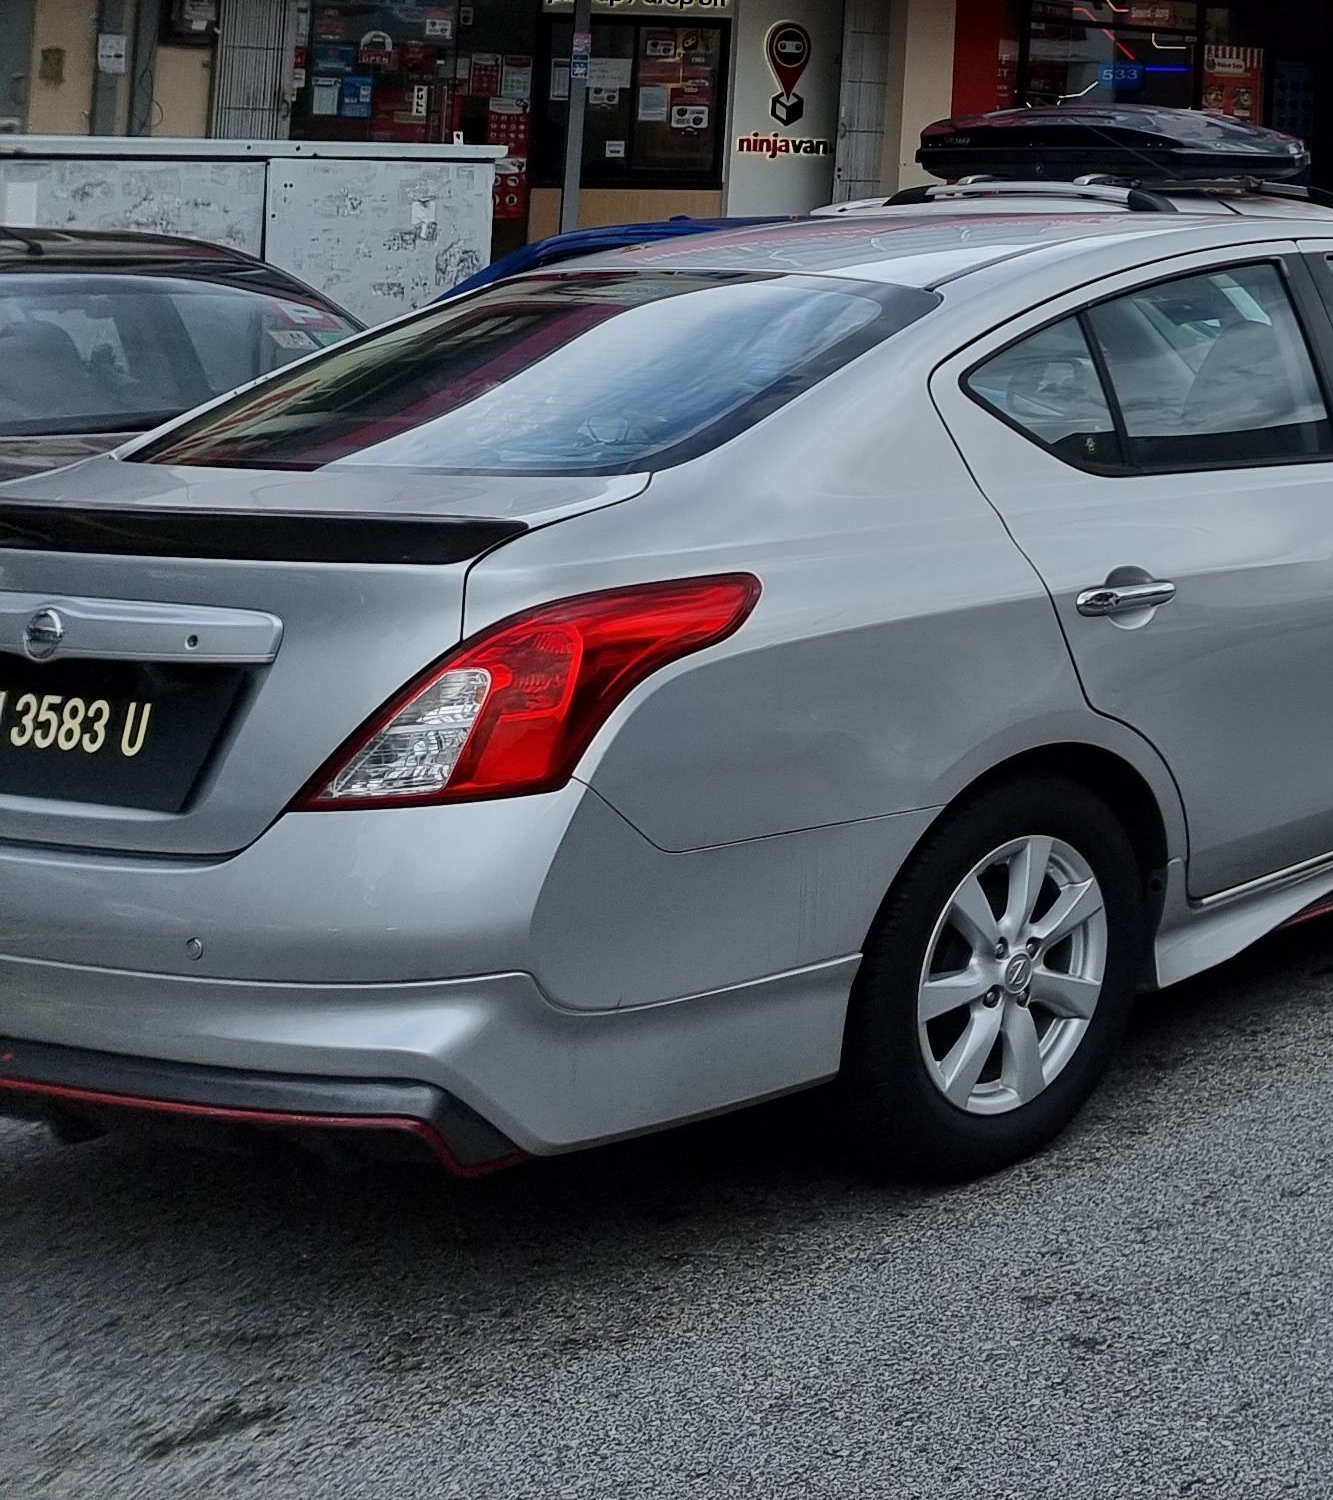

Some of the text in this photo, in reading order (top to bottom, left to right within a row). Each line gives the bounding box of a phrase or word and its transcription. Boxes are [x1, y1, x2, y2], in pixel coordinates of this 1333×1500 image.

[1102, 68, 1138, 81] 533
[415, 86, 425, 115] PULL
[738, 131, 829, 159] ninjavan
[10, 692, 110, 755] 3583
[121, 701, 152, 757] U
